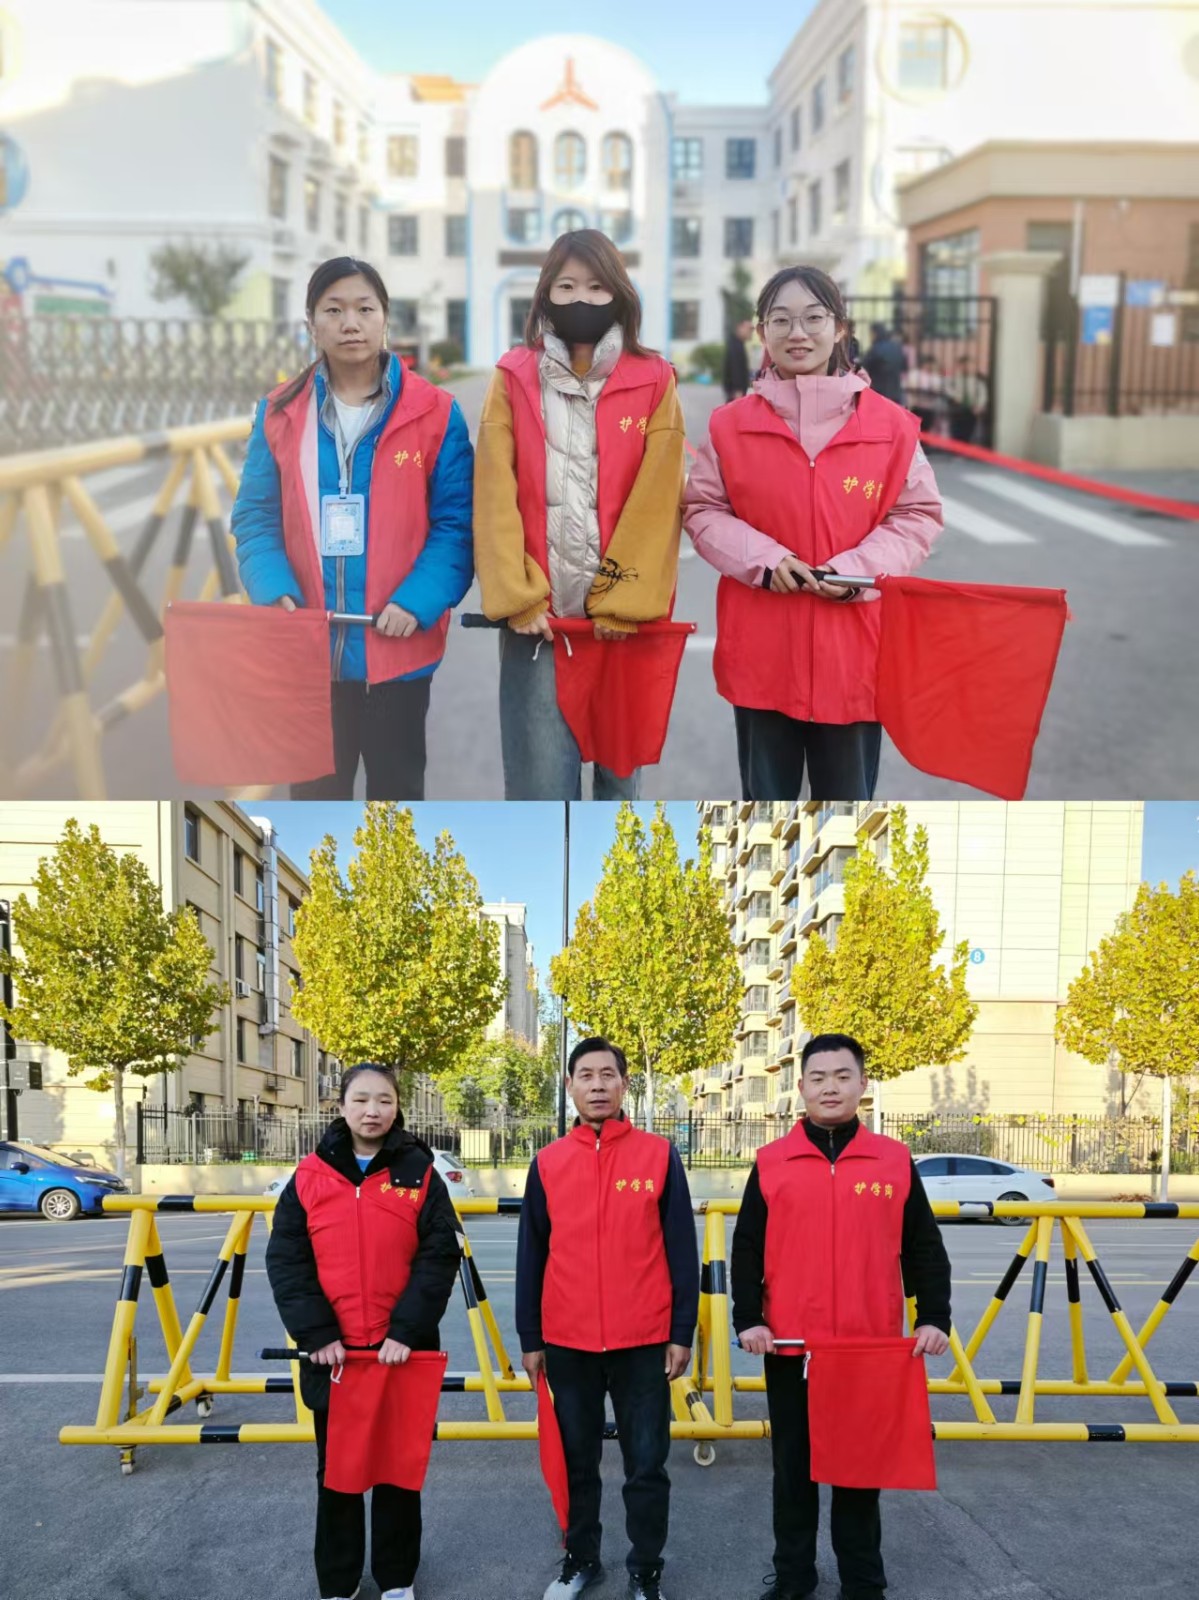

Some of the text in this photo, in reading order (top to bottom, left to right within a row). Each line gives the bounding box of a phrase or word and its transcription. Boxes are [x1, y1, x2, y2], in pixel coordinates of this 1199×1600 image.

[974, 951, 982, 962] 8
[380, 1182, 420, 1202] 护学岗
[615, 1179, 654, 1192] 护学岗
[854, 1182, 893, 1199] 护学岗
